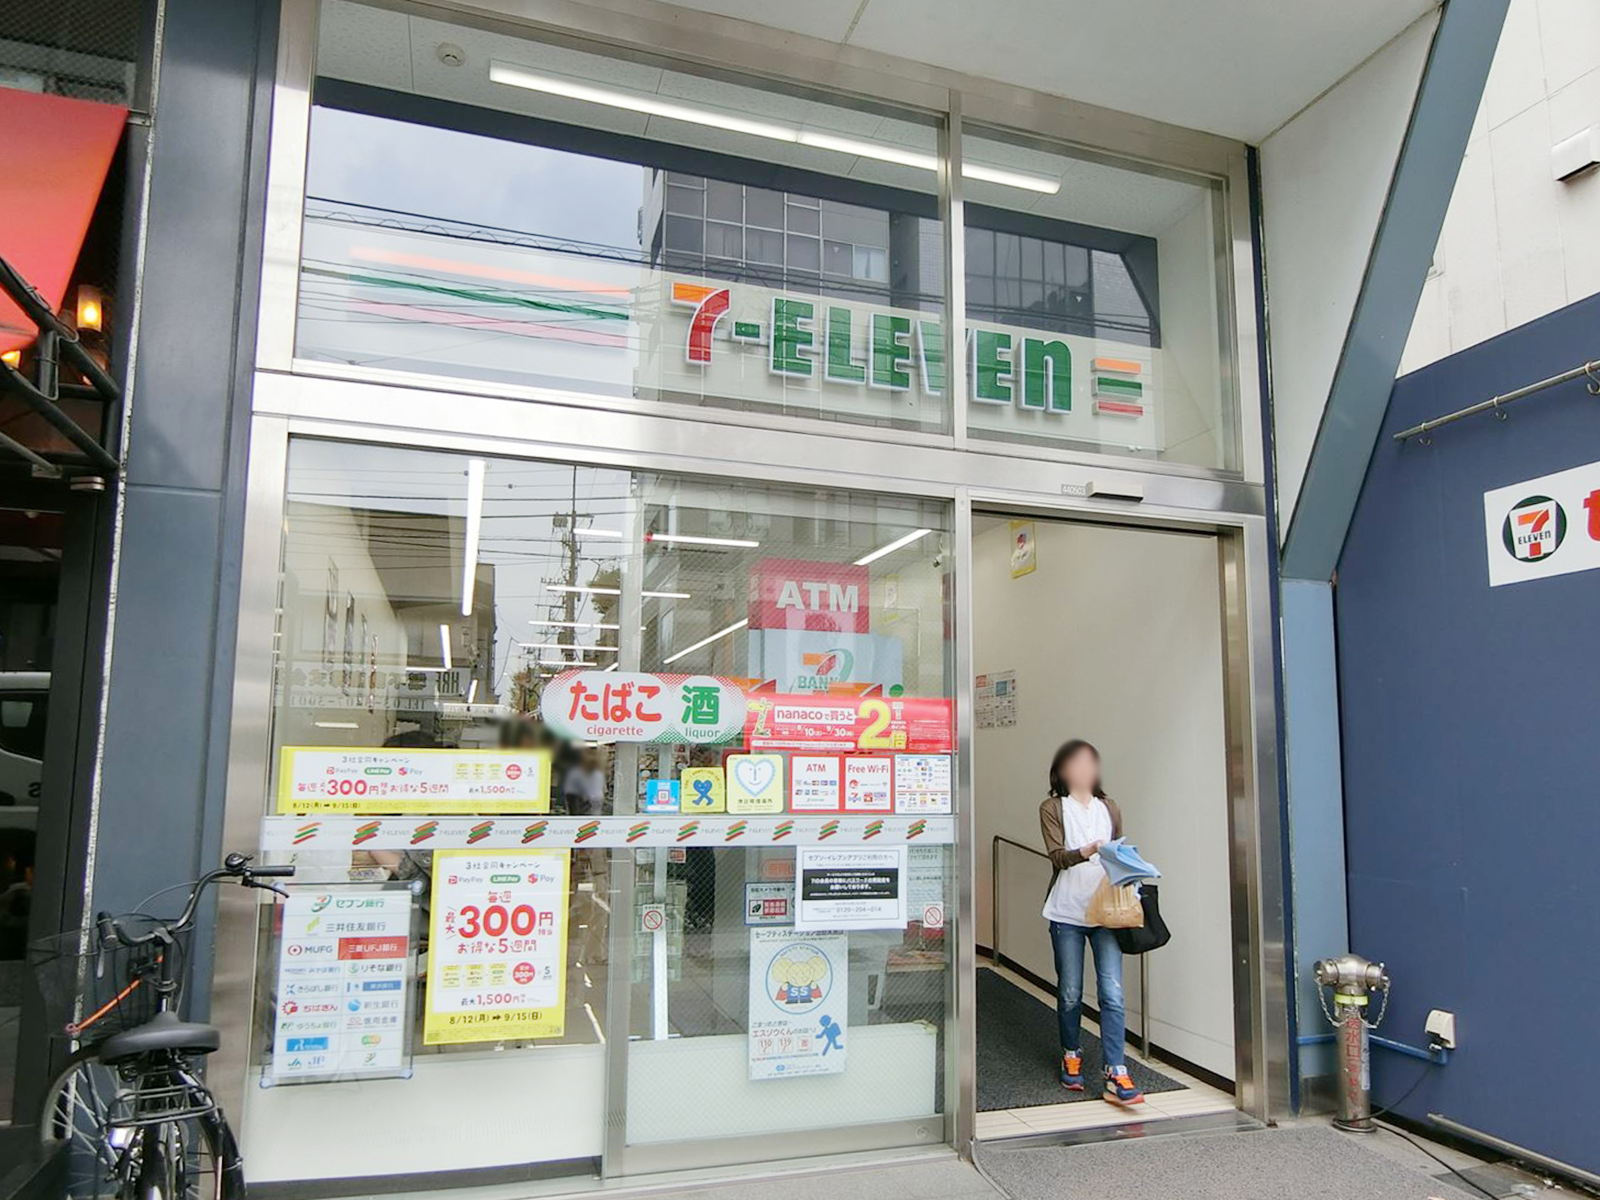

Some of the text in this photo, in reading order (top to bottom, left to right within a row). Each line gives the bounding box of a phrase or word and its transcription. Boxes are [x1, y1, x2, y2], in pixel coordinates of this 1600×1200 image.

[776, 580, 859, 613] ATM
[568, 680, 721, 725] たばこ 酒
[586, 724, 721, 739] cigarette liquor
[805, 763, 826, 773] ATM
[848, 764, 889, 774] Free Wi-Fi
[465, 861, 541, 870] 3社合同キャンペーン
[540, 874, 555, 883] Pay
[488, 890, 512, 903] 毎週
[335, 898, 385, 909] セブン銀行
[458, 904, 554, 938] 300円
[325, 921, 387, 933] 三井住友銀行
[304, 945, 333, 954] MUFG
[348, 943, 398, 953] 三菱UFJ銀行
[457, 938, 537, 954] お得な5週間
[361, 963, 403, 973] りそな銀行
[790, 986, 809, 997] SS
[303, 1004, 339, 1013] ちばぎん
[449, 1011, 543, 1025] 8/12(月) 9/15(日)
[296, 1021, 337, 1030] ゆうちょ銀行
